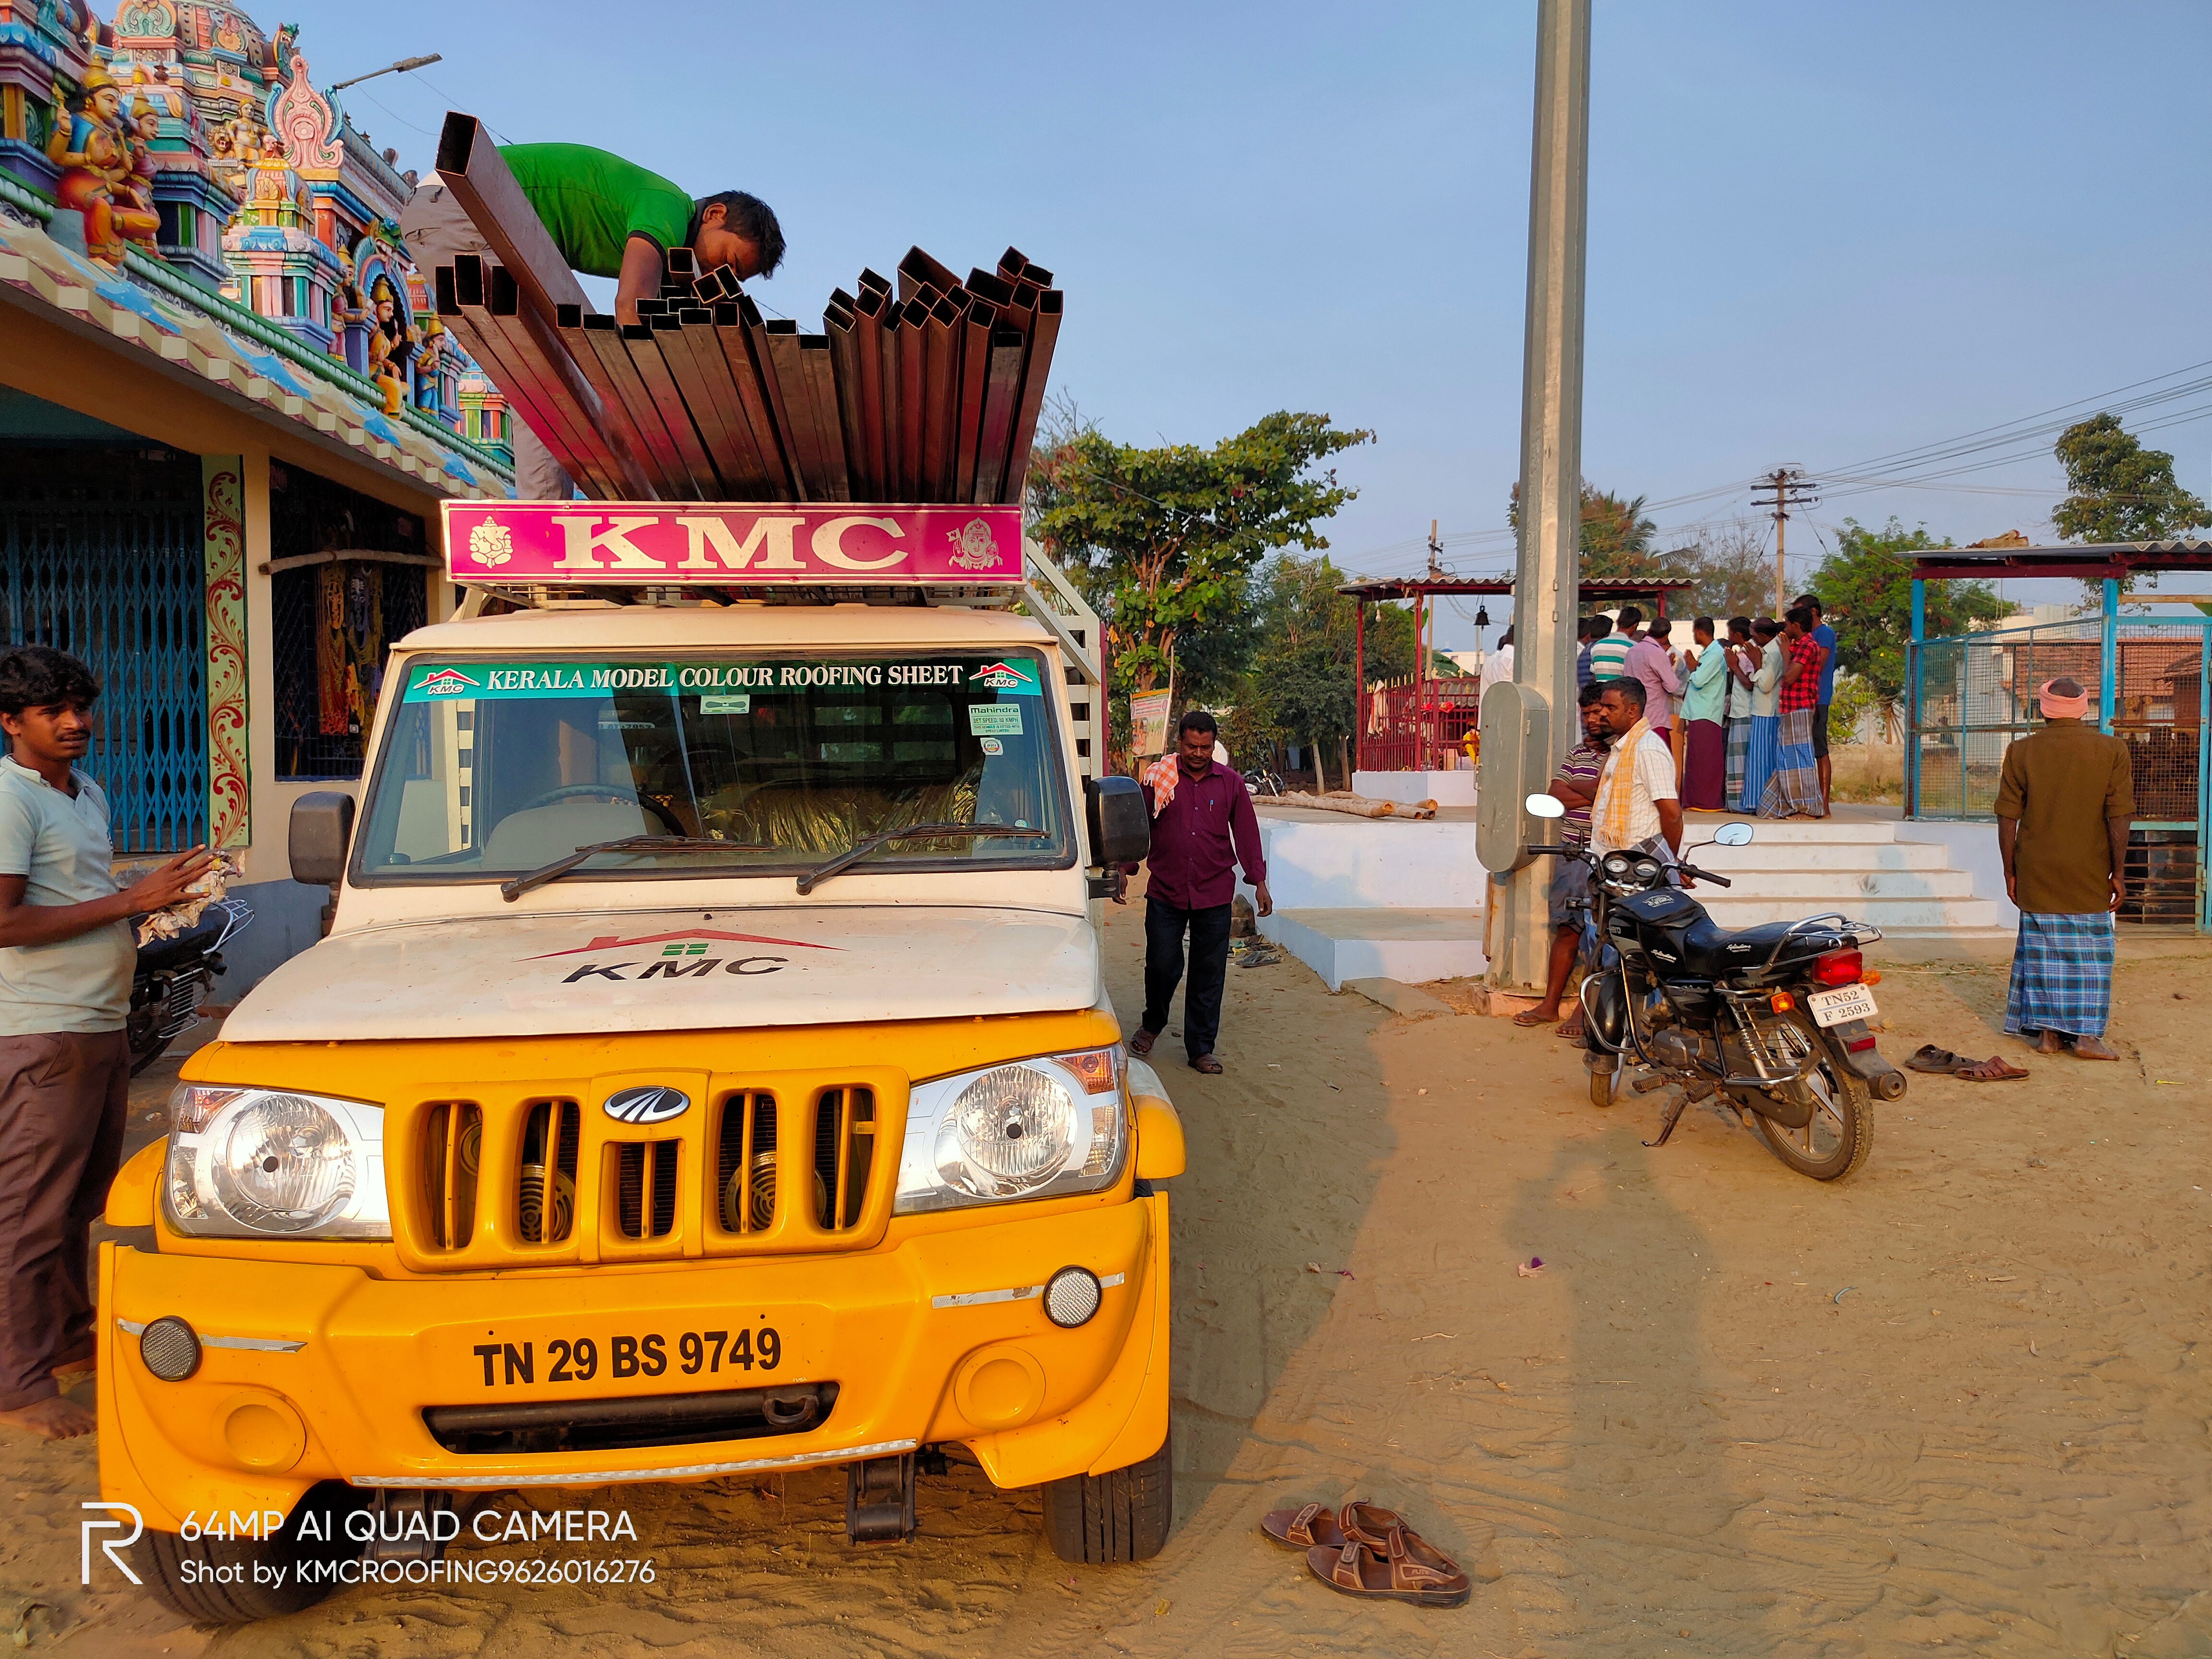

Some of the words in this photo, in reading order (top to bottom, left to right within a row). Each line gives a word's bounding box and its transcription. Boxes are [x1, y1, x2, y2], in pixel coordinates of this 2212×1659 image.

[553, 517, 908, 570] KMC
[487, 670, 584, 690] KERALA
[590, 669, 674, 688] MODEL
[680, 668, 773, 687] COLOUR
[780, 666, 881, 686] ROOFING
[888, 665, 963, 685] SHEET
[984, 676, 1018, 687] KMC
[428, 684, 464, 694] KMC
[560, 957, 789, 983] KMC
[1821, 990, 1860, 1006] TN52
[1823, 1011, 1833, 1022] F
[1839, 1003, 1870, 1018] 2593
[473, 1342, 534, 1386] TN
[547, 1338, 598, 1382] 29
[612, 1334, 668, 1379] BS
[679, 1328, 781, 1375] 9749
